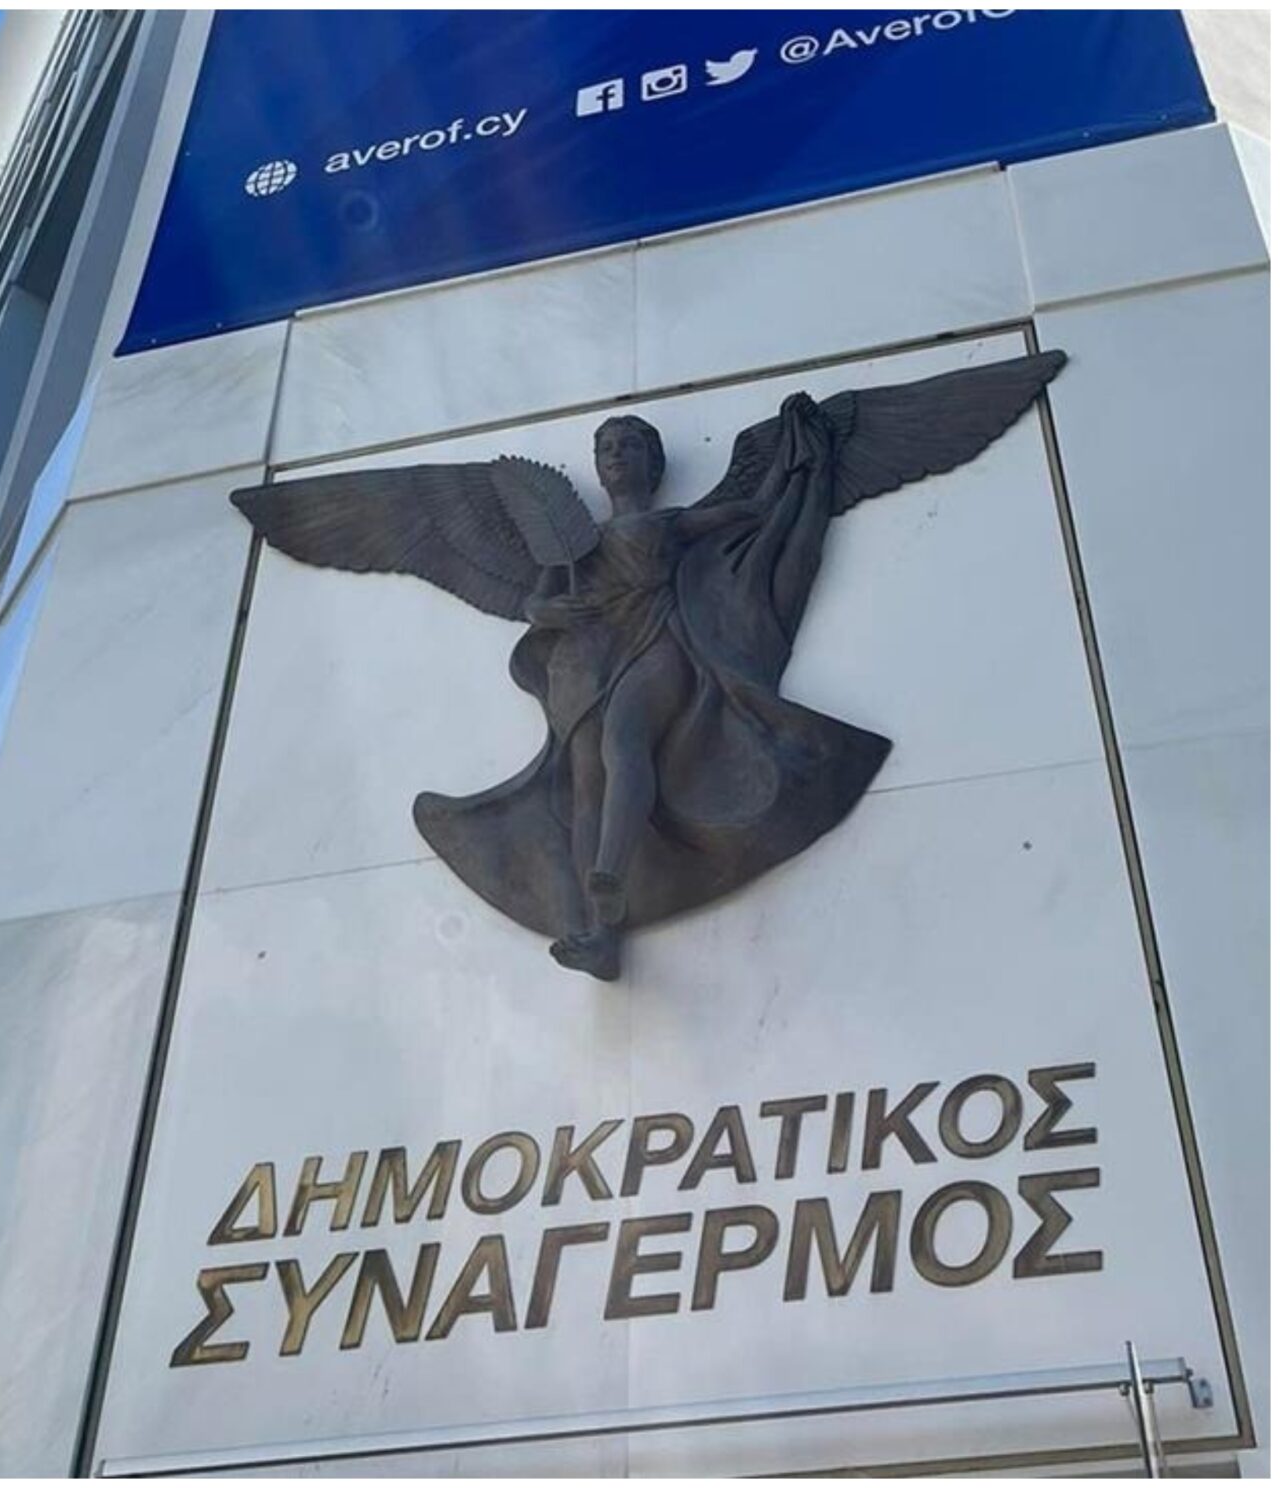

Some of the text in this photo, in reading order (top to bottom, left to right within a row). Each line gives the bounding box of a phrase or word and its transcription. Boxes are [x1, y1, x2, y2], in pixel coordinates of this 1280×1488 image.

[324, 108, 528, 174] averof.cy
[207, 1062, 1098, 1245] ΔΗΜΟΚΡΑΤΙΚΟΣ
[169, 1167, 1104, 1367] ΣΥΝΑΓΕΡΜΟΣ
